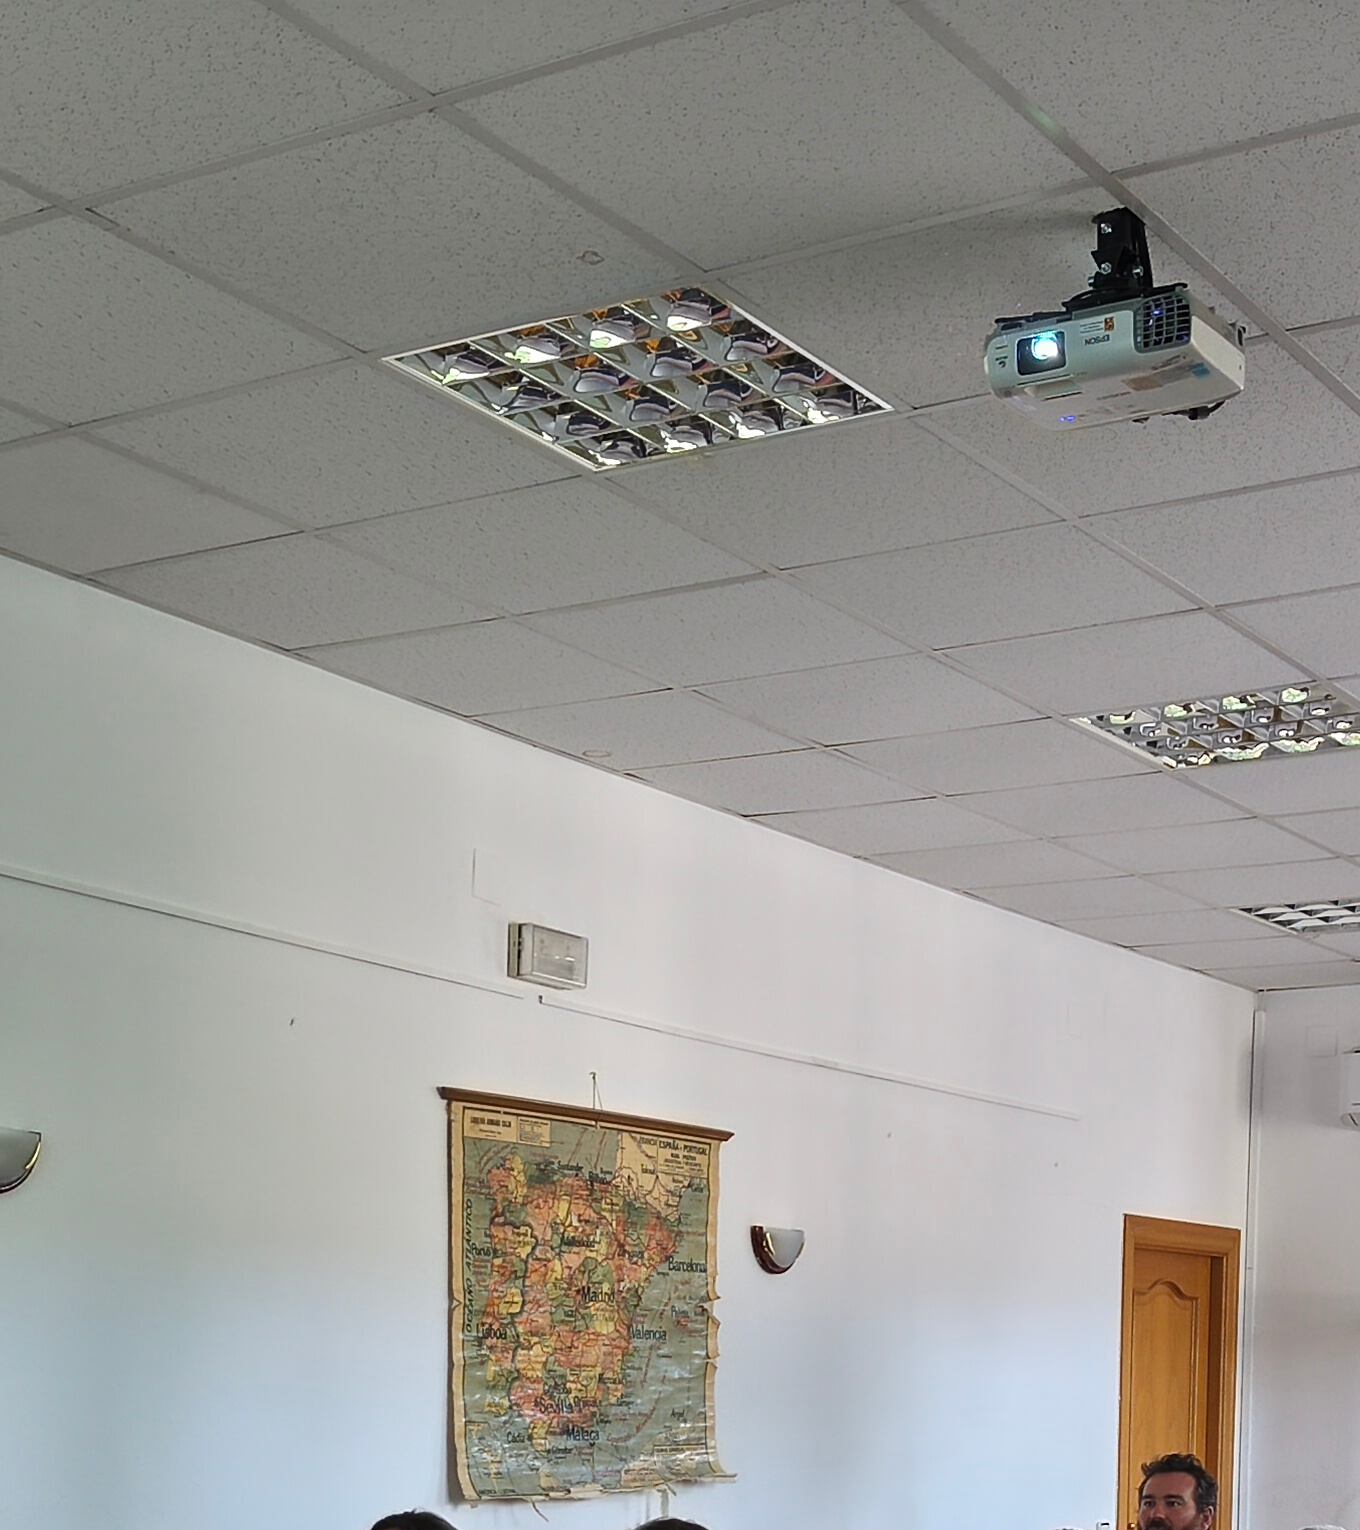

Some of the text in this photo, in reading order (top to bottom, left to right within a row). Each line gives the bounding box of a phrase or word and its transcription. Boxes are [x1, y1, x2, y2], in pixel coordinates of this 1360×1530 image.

[1084, 334, 1110, 346] EPSON
[668, 1257, 707, 1273] Barcelona
[581, 1286, 615, 1303] Madrid
[476, 1323, 507, 1340] Lisboa
[631, 1324, 667, 1341] Valencia
